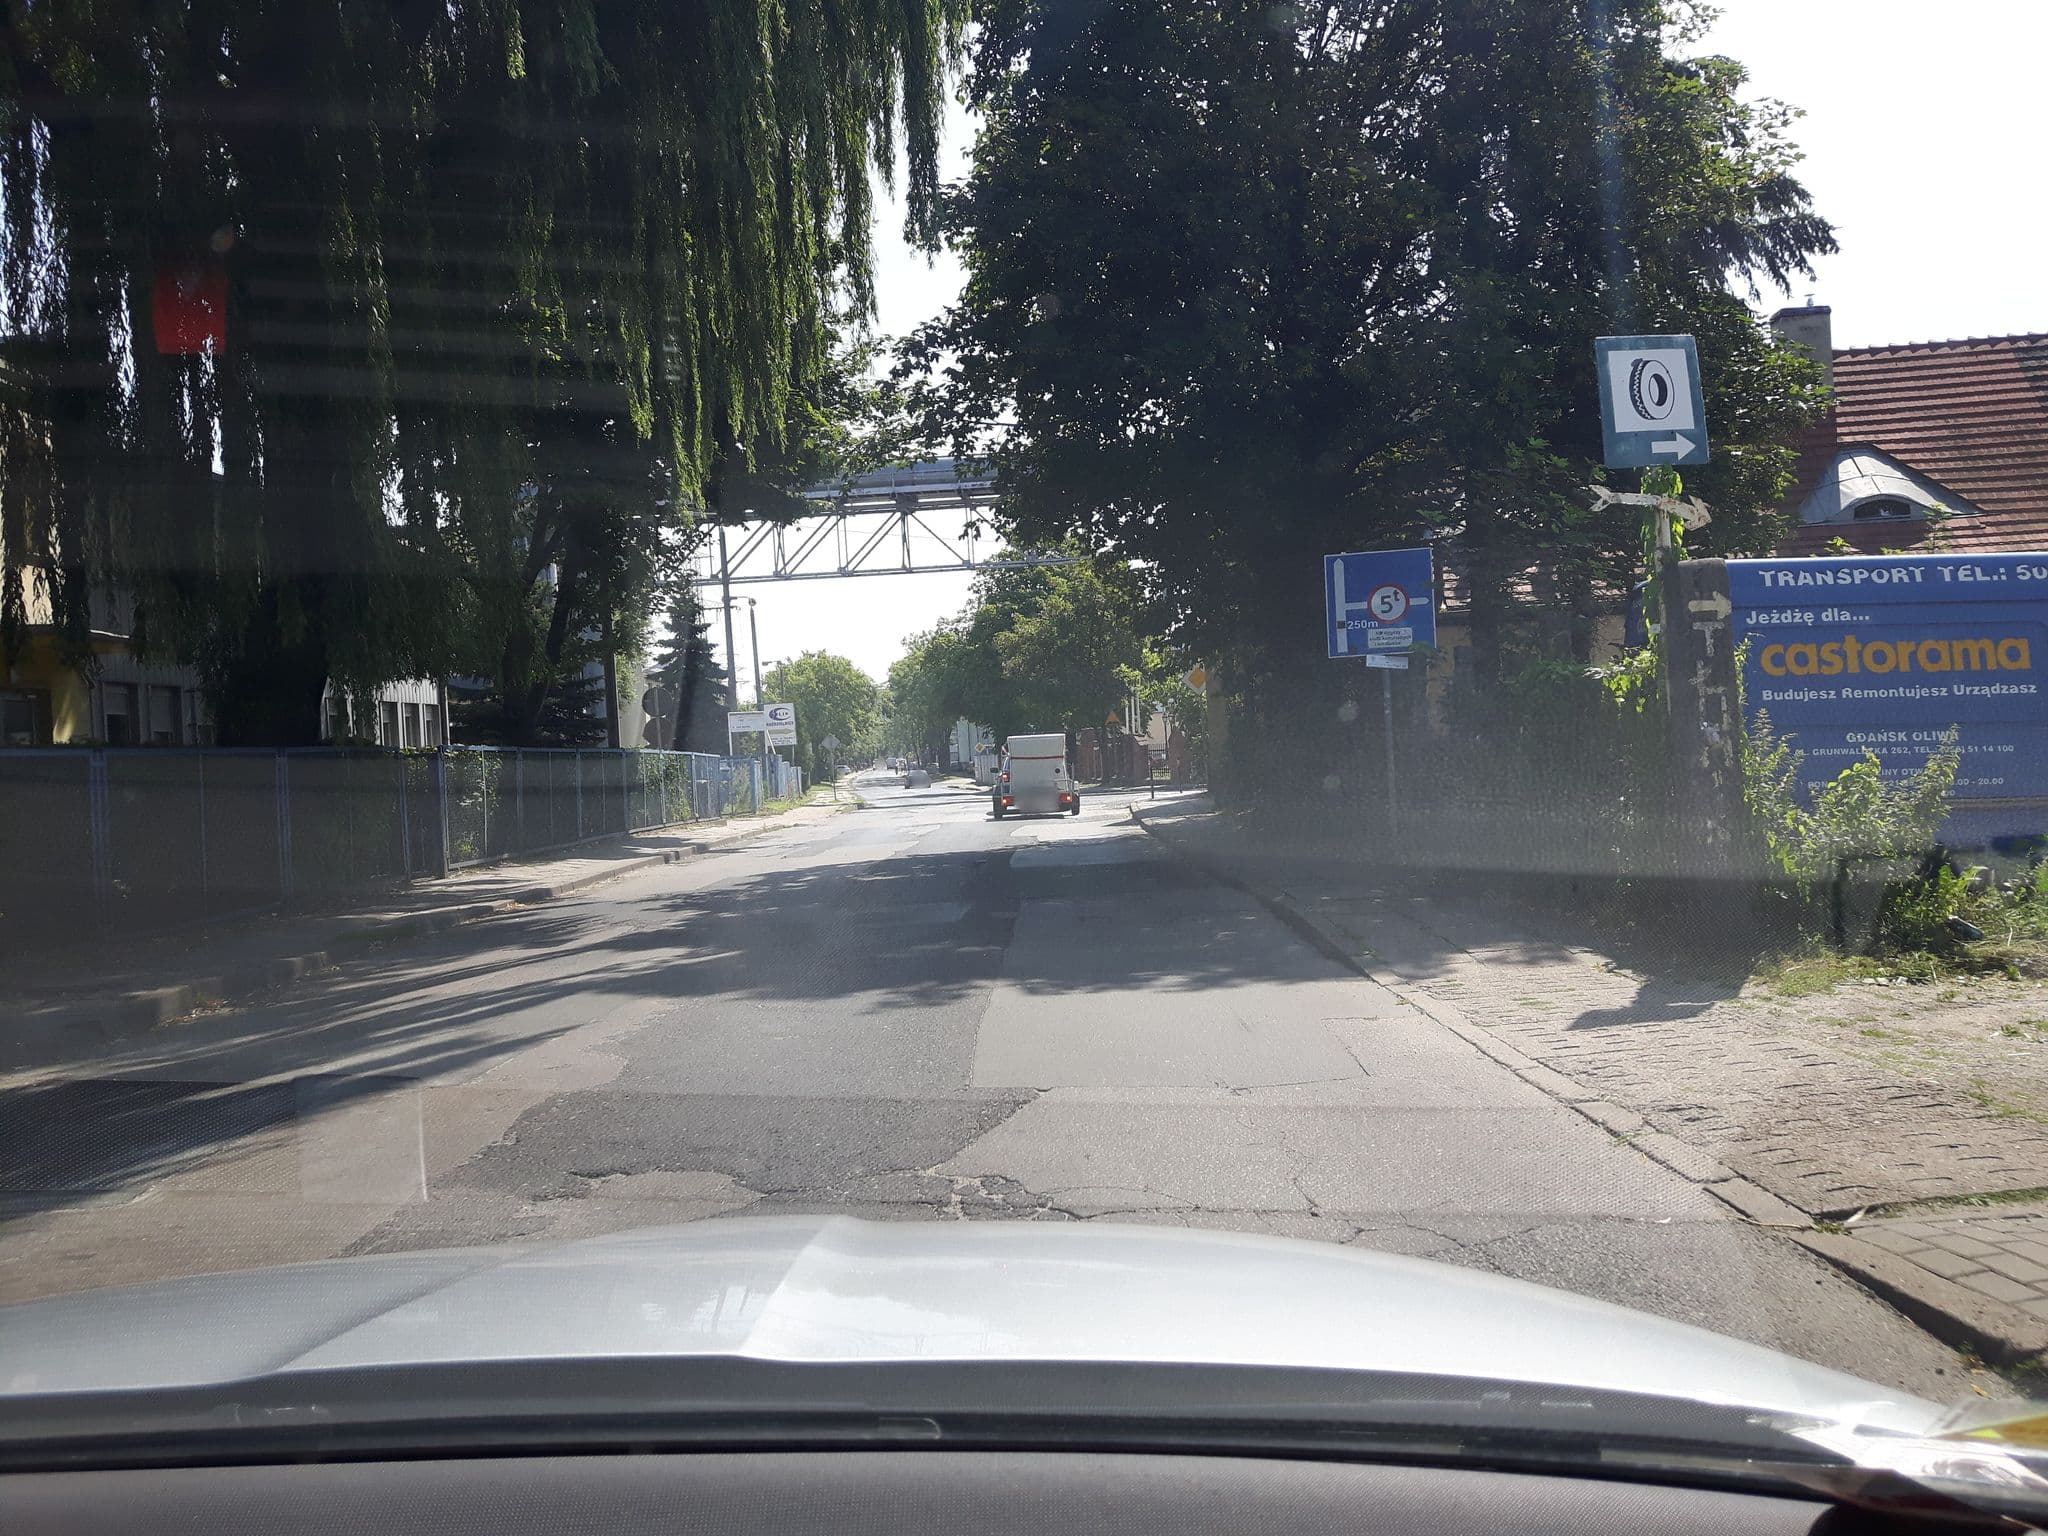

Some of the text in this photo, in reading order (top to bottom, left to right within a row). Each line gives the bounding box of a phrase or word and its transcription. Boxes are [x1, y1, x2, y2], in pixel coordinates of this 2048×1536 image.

[1758, 566, 1926, 587] TRANSPORT
[1937, 565, 2007, 582] TEL.:
[1347, 619, 1379, 631] 250m
[1746, 607, 1870, 626] Jeżdżę dla...
[1760, 634, 2032, 677] castorama
[1762, 682, 2038, 702] Budujesz Remontujesz Urządzasz
[1846, 729, 1908, 742] GDAŃSK
[1997, 744, 2014, 752] 100
